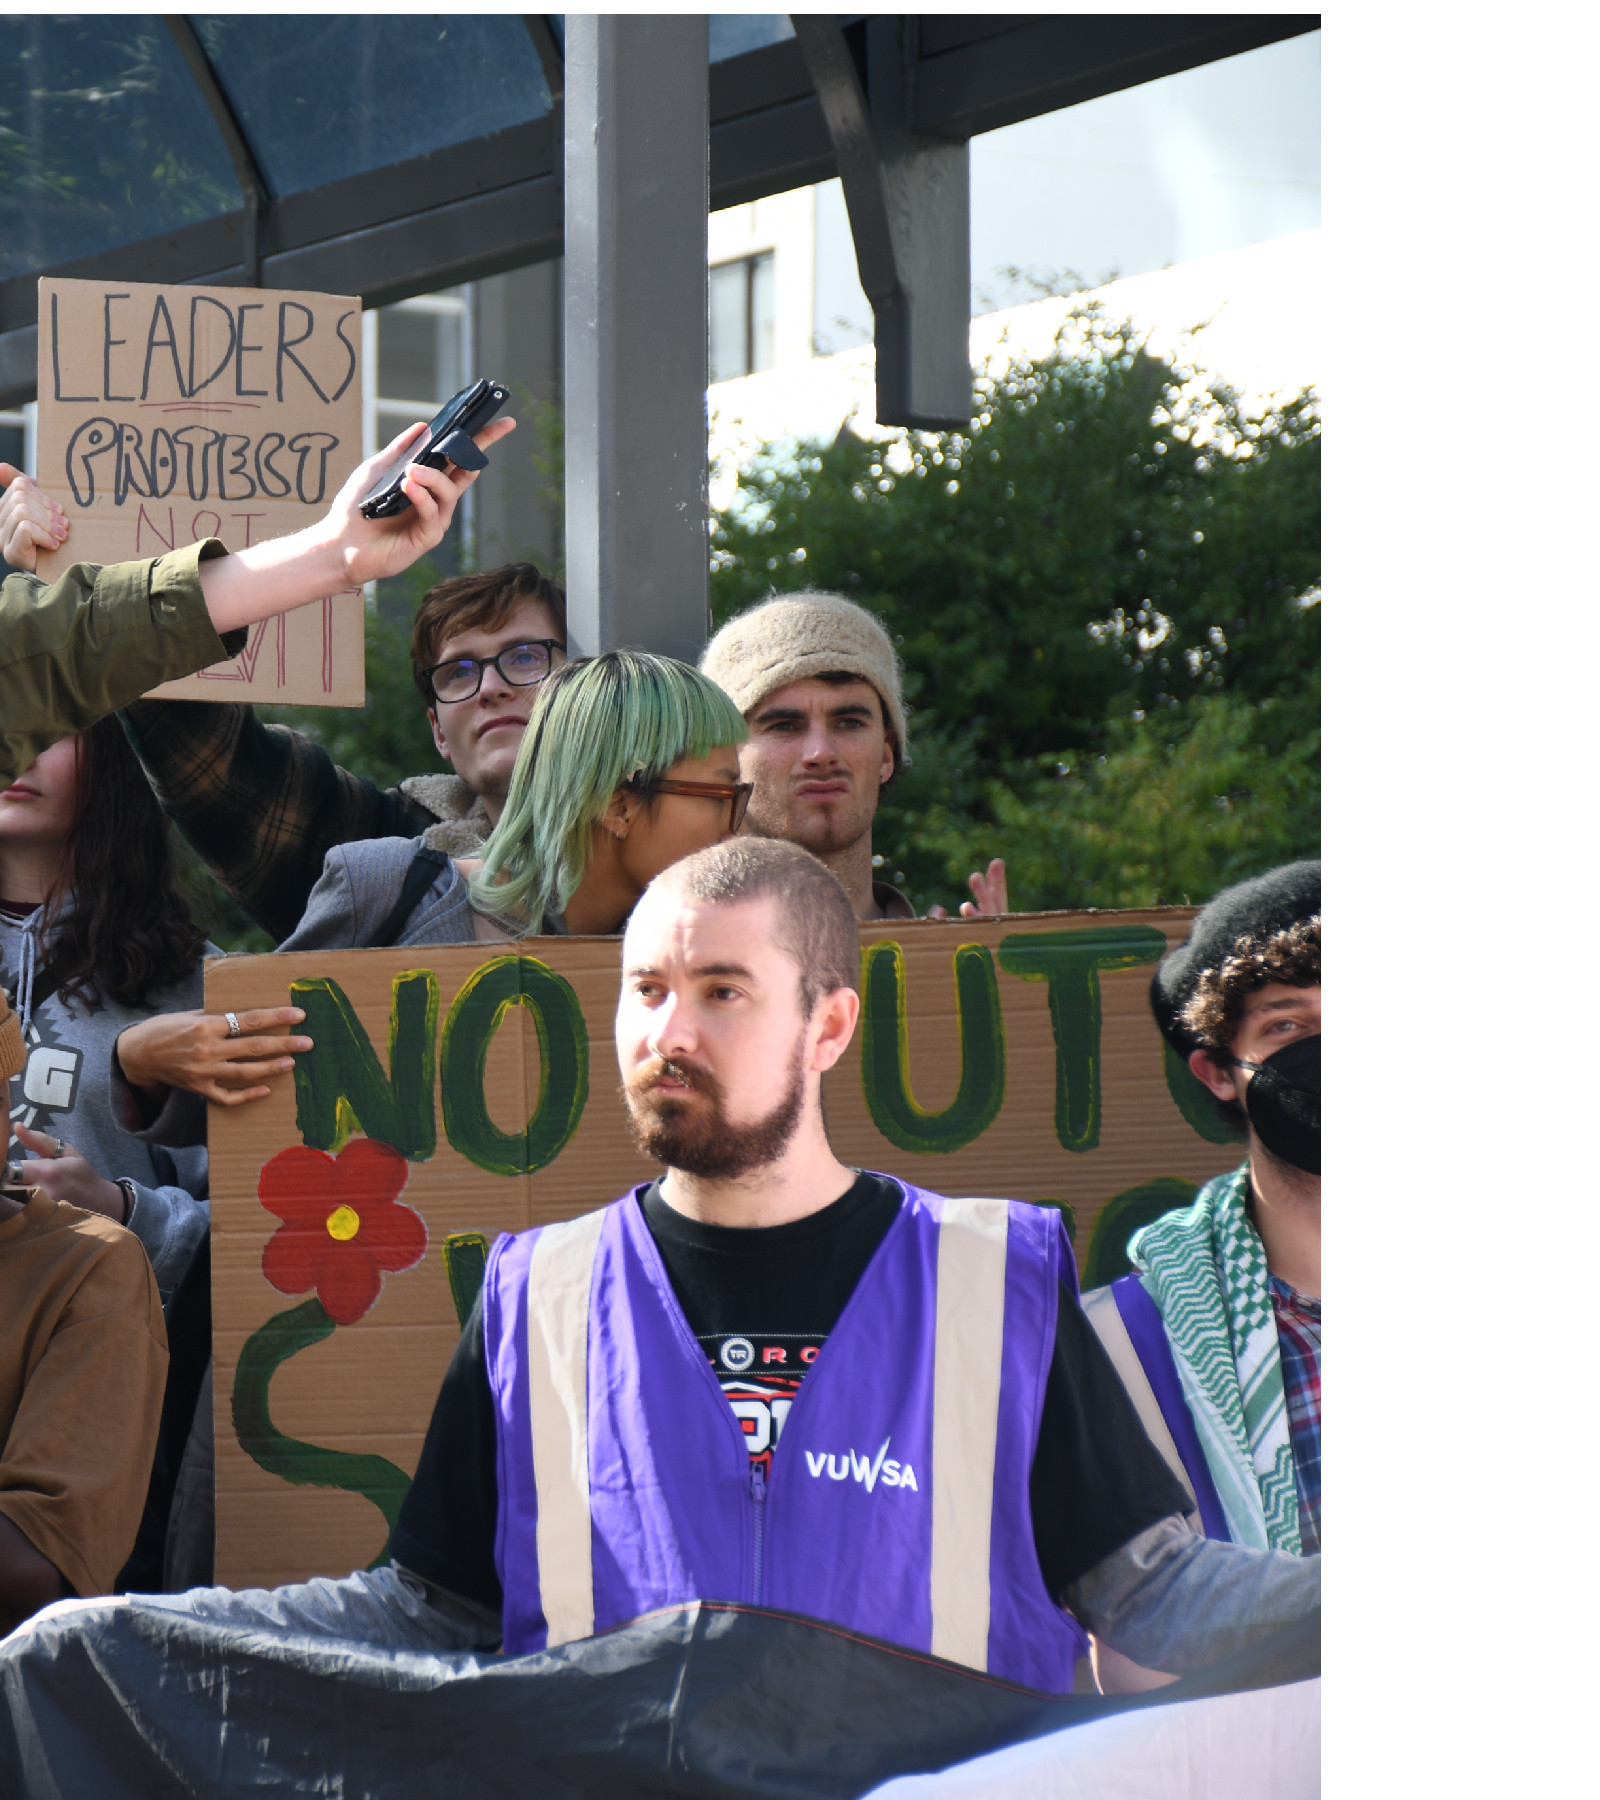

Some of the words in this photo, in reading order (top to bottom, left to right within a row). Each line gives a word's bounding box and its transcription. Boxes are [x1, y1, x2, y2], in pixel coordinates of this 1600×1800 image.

[51, 292, 357, 404] LEADERS
[66, 417, 339, 508] PROTECT
[136, 503, 266, 552] NOT
[290, 954, 589, 1177] NO
[805, 1436, 918, 1493] VUWSA
